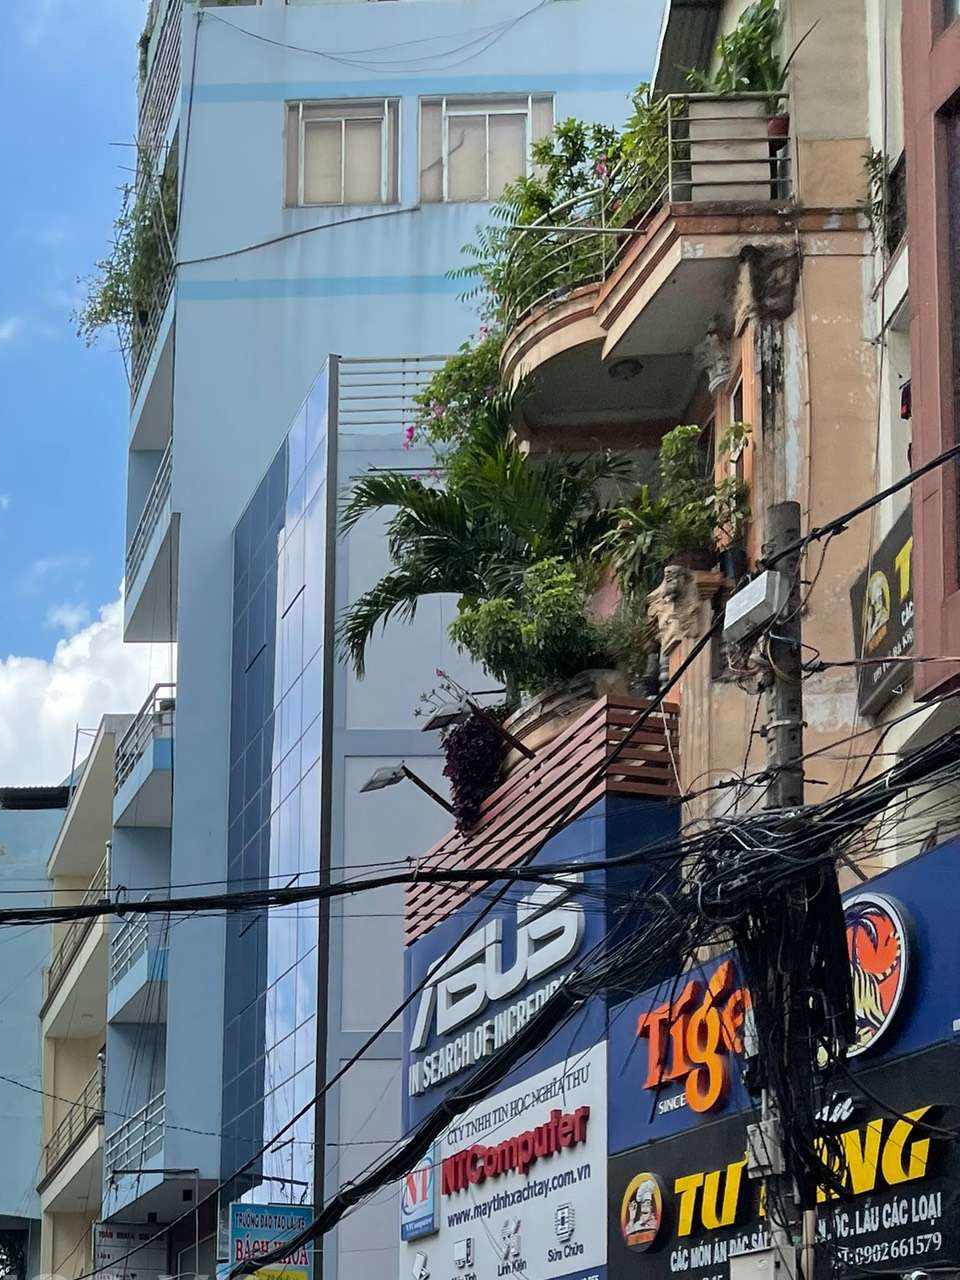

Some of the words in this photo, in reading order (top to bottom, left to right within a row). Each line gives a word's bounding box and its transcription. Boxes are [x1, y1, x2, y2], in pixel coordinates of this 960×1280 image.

[409, 1061, 424, 1097] IN
[422, 1030, 476, 1088] SEARCH
[473, 1020, 494, 1060] OF
[636, 960, 753, 1114] Tige
[446, 1125, 465, 1147] CTY
[466, 1116, 491, 1138] TNHH
[492, 1103, 509, 1125] TIN
[509, 1096, 530, 1119] HỌC
[565, 1062, 591, 1091] THƯ
[657, 1092, 688, 1115] SINCE
[441, 1106, 591, 1197] NTComputer
[447, 1164, 591, 1228] www.maytinhxachtay.com.vn
[670, 1245, 690, 1273] CÁC
[690, 1240, 712, 1269] MÓN
[882, 1196, 909, 1230] CÁC
[911, 1192, 942, 1226] LOẠI
[547, 1248, 563, 1263] Sửa
